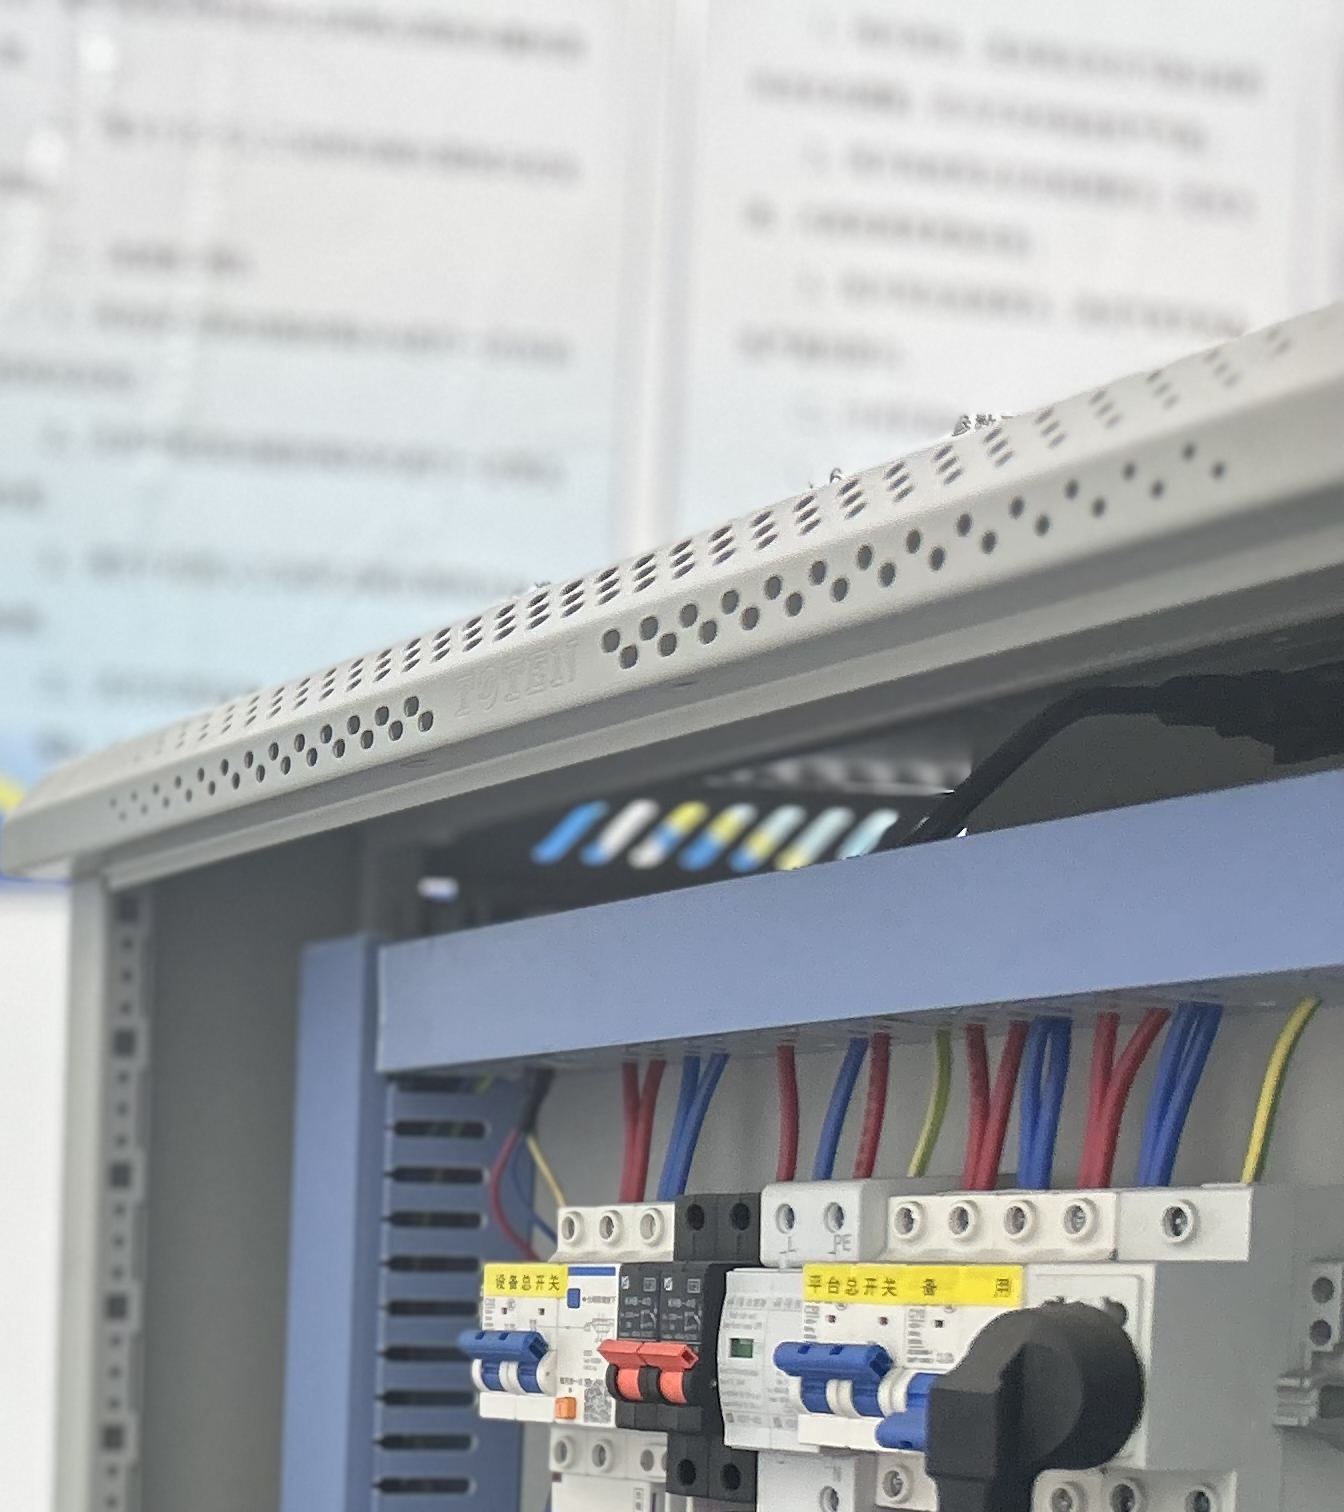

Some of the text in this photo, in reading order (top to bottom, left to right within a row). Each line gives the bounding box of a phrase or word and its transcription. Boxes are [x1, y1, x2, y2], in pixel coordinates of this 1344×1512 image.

[833, 1233, 852, 1252] PE
[495, 1273, 560, 1292] 设备总开关
[807, 1274, 898, 1298] 平台总开关
